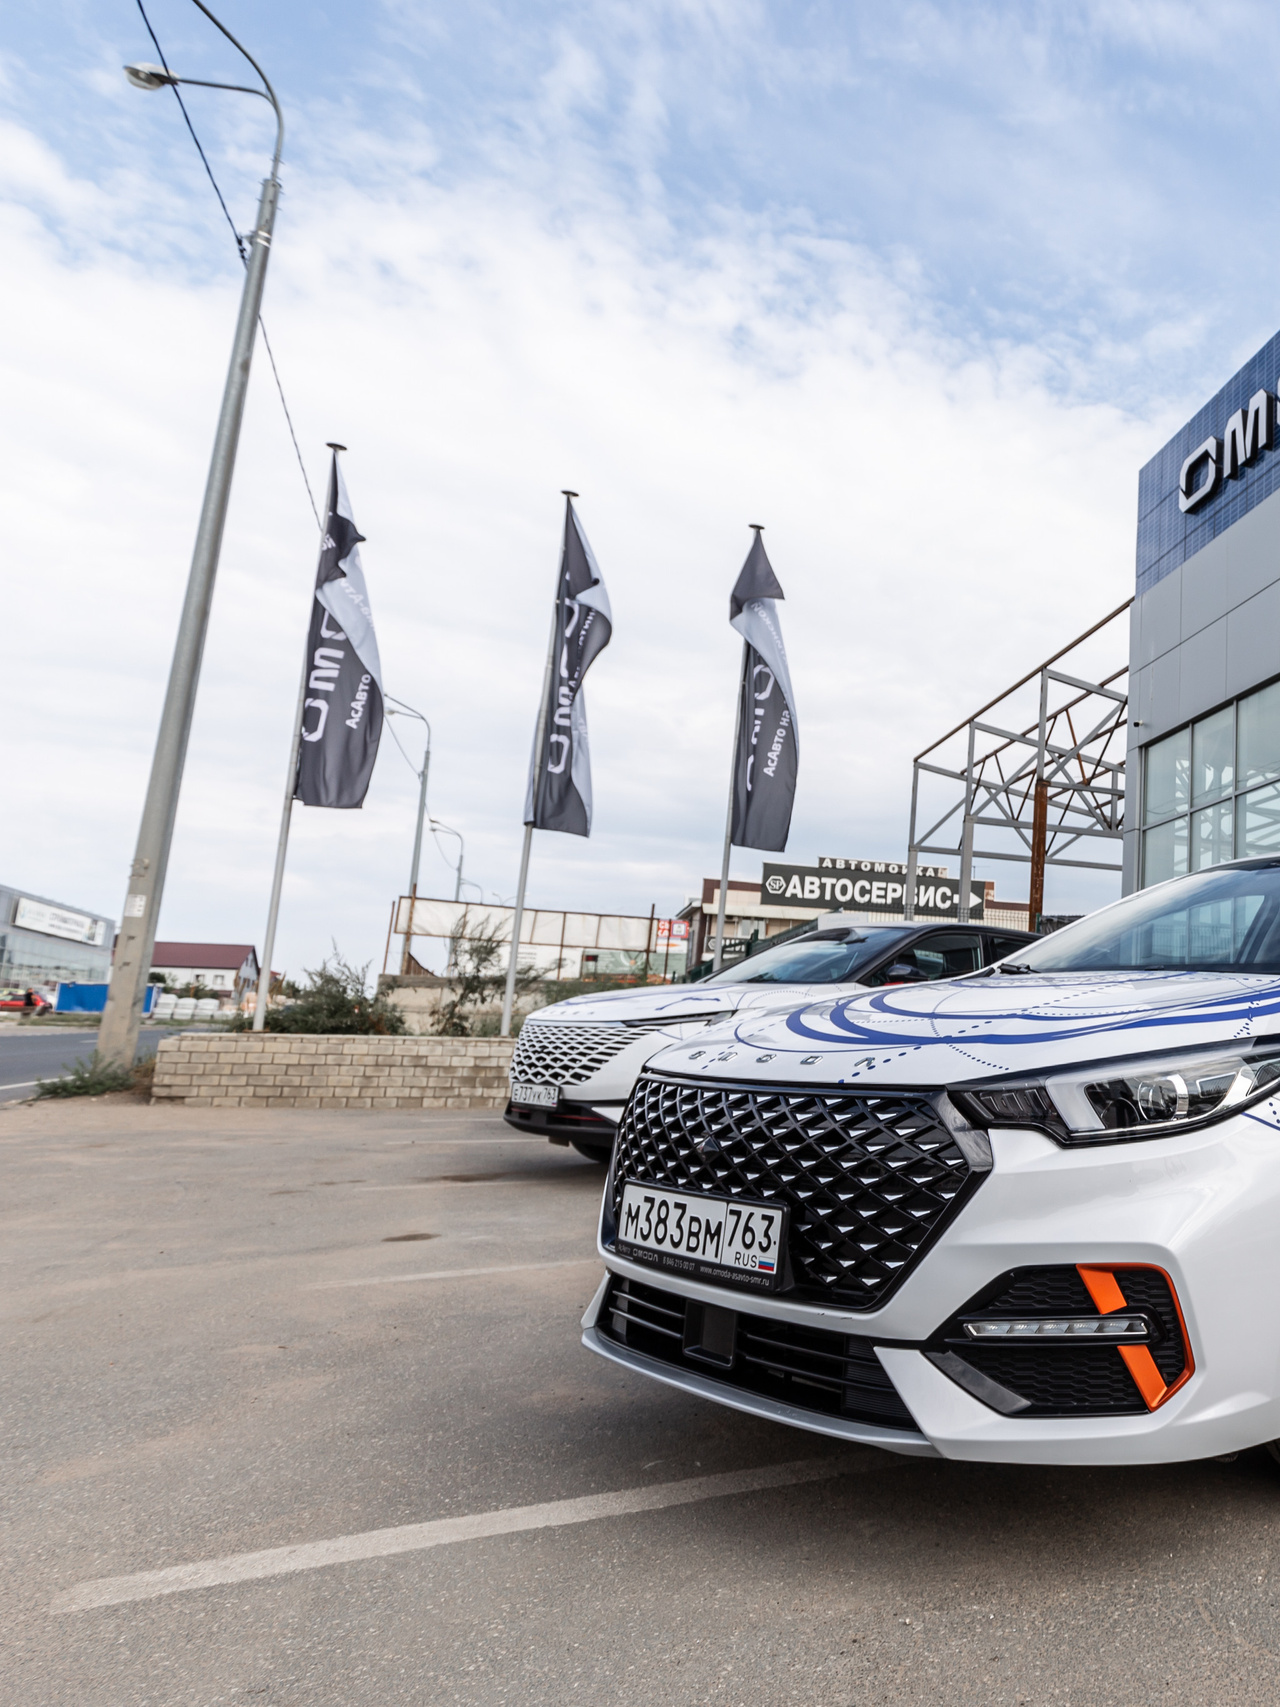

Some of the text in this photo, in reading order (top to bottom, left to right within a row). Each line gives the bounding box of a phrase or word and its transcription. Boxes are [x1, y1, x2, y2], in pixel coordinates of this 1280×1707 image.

[302, 608, 348, 742] OMO
[727, 1209, 775, 1253] 763
[733, 1251, 758, 1268] RUS
